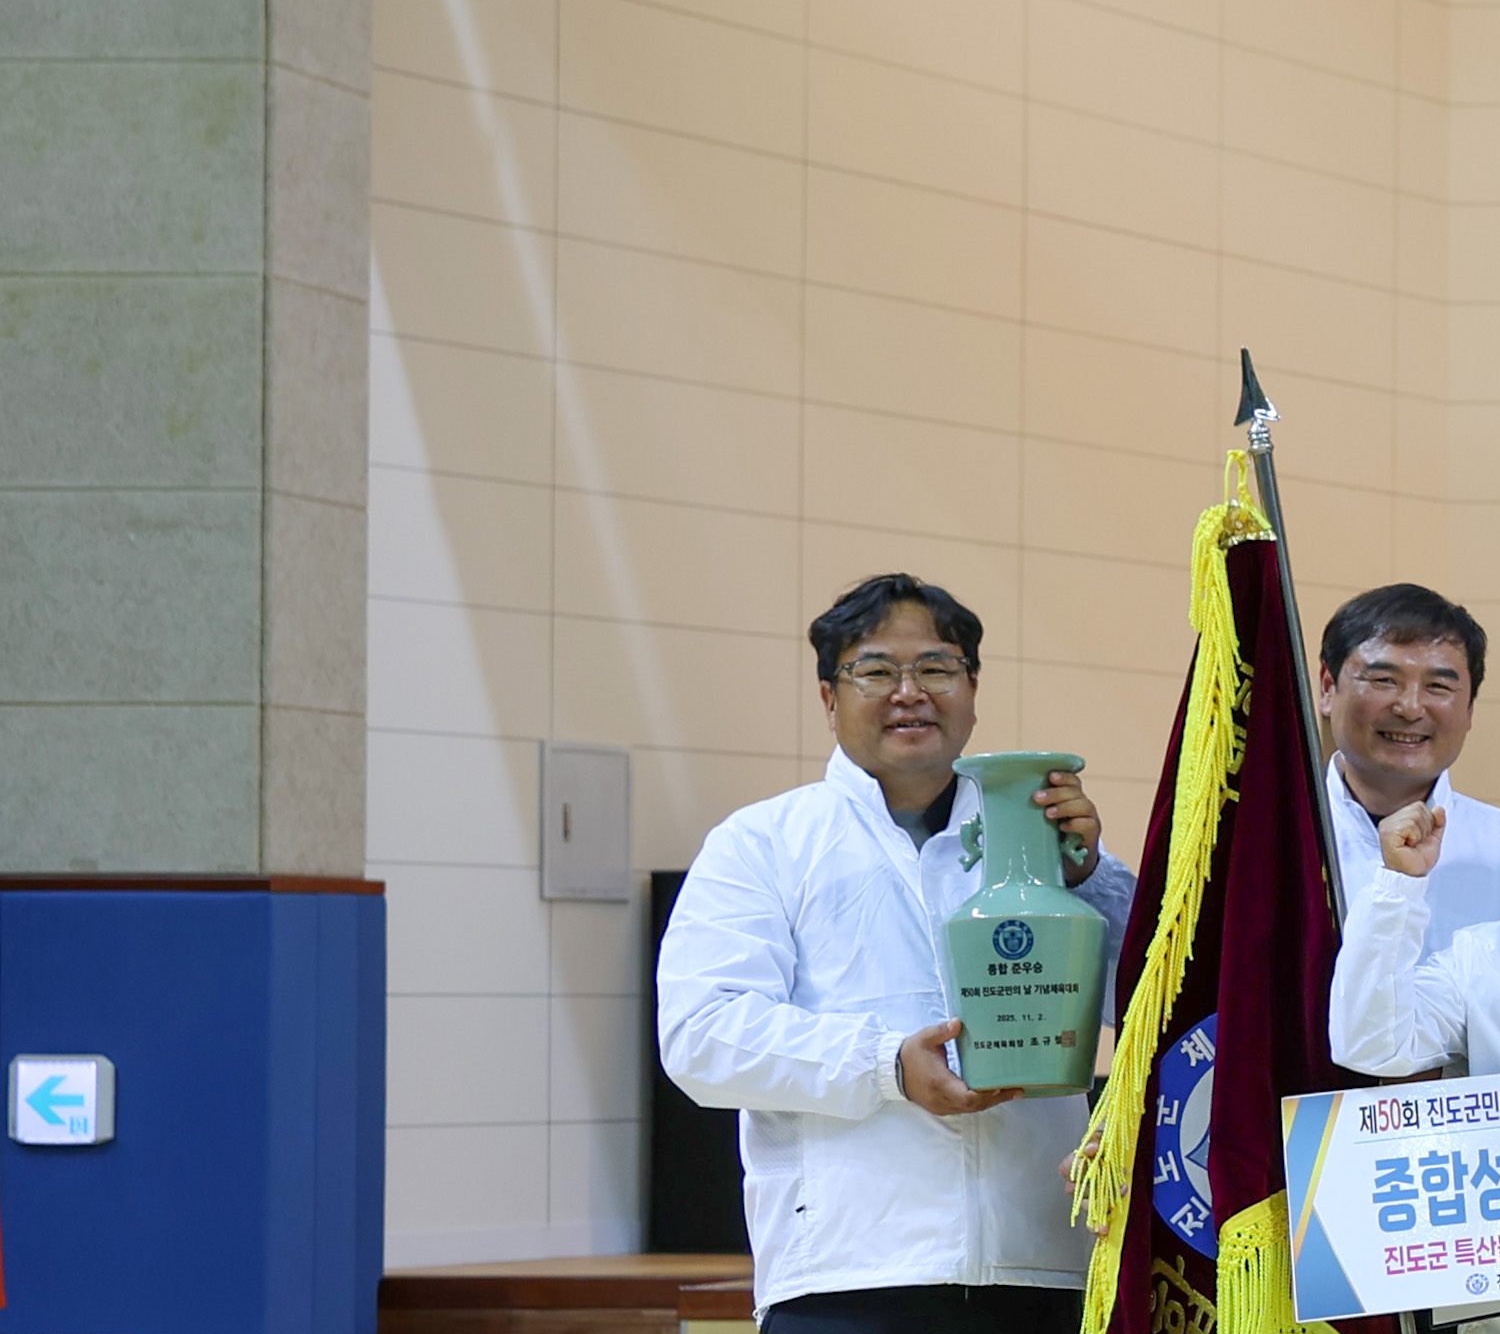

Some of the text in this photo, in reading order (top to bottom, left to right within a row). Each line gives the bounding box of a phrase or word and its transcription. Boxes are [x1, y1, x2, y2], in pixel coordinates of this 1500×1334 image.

[982, 985, 1021, 997] 진도군민의
[1023, 985, 1032, 995] 날
[1359, 1097, 1420, 1133] 제50회
[1384, 1240, 1449, 1276] 진도군
